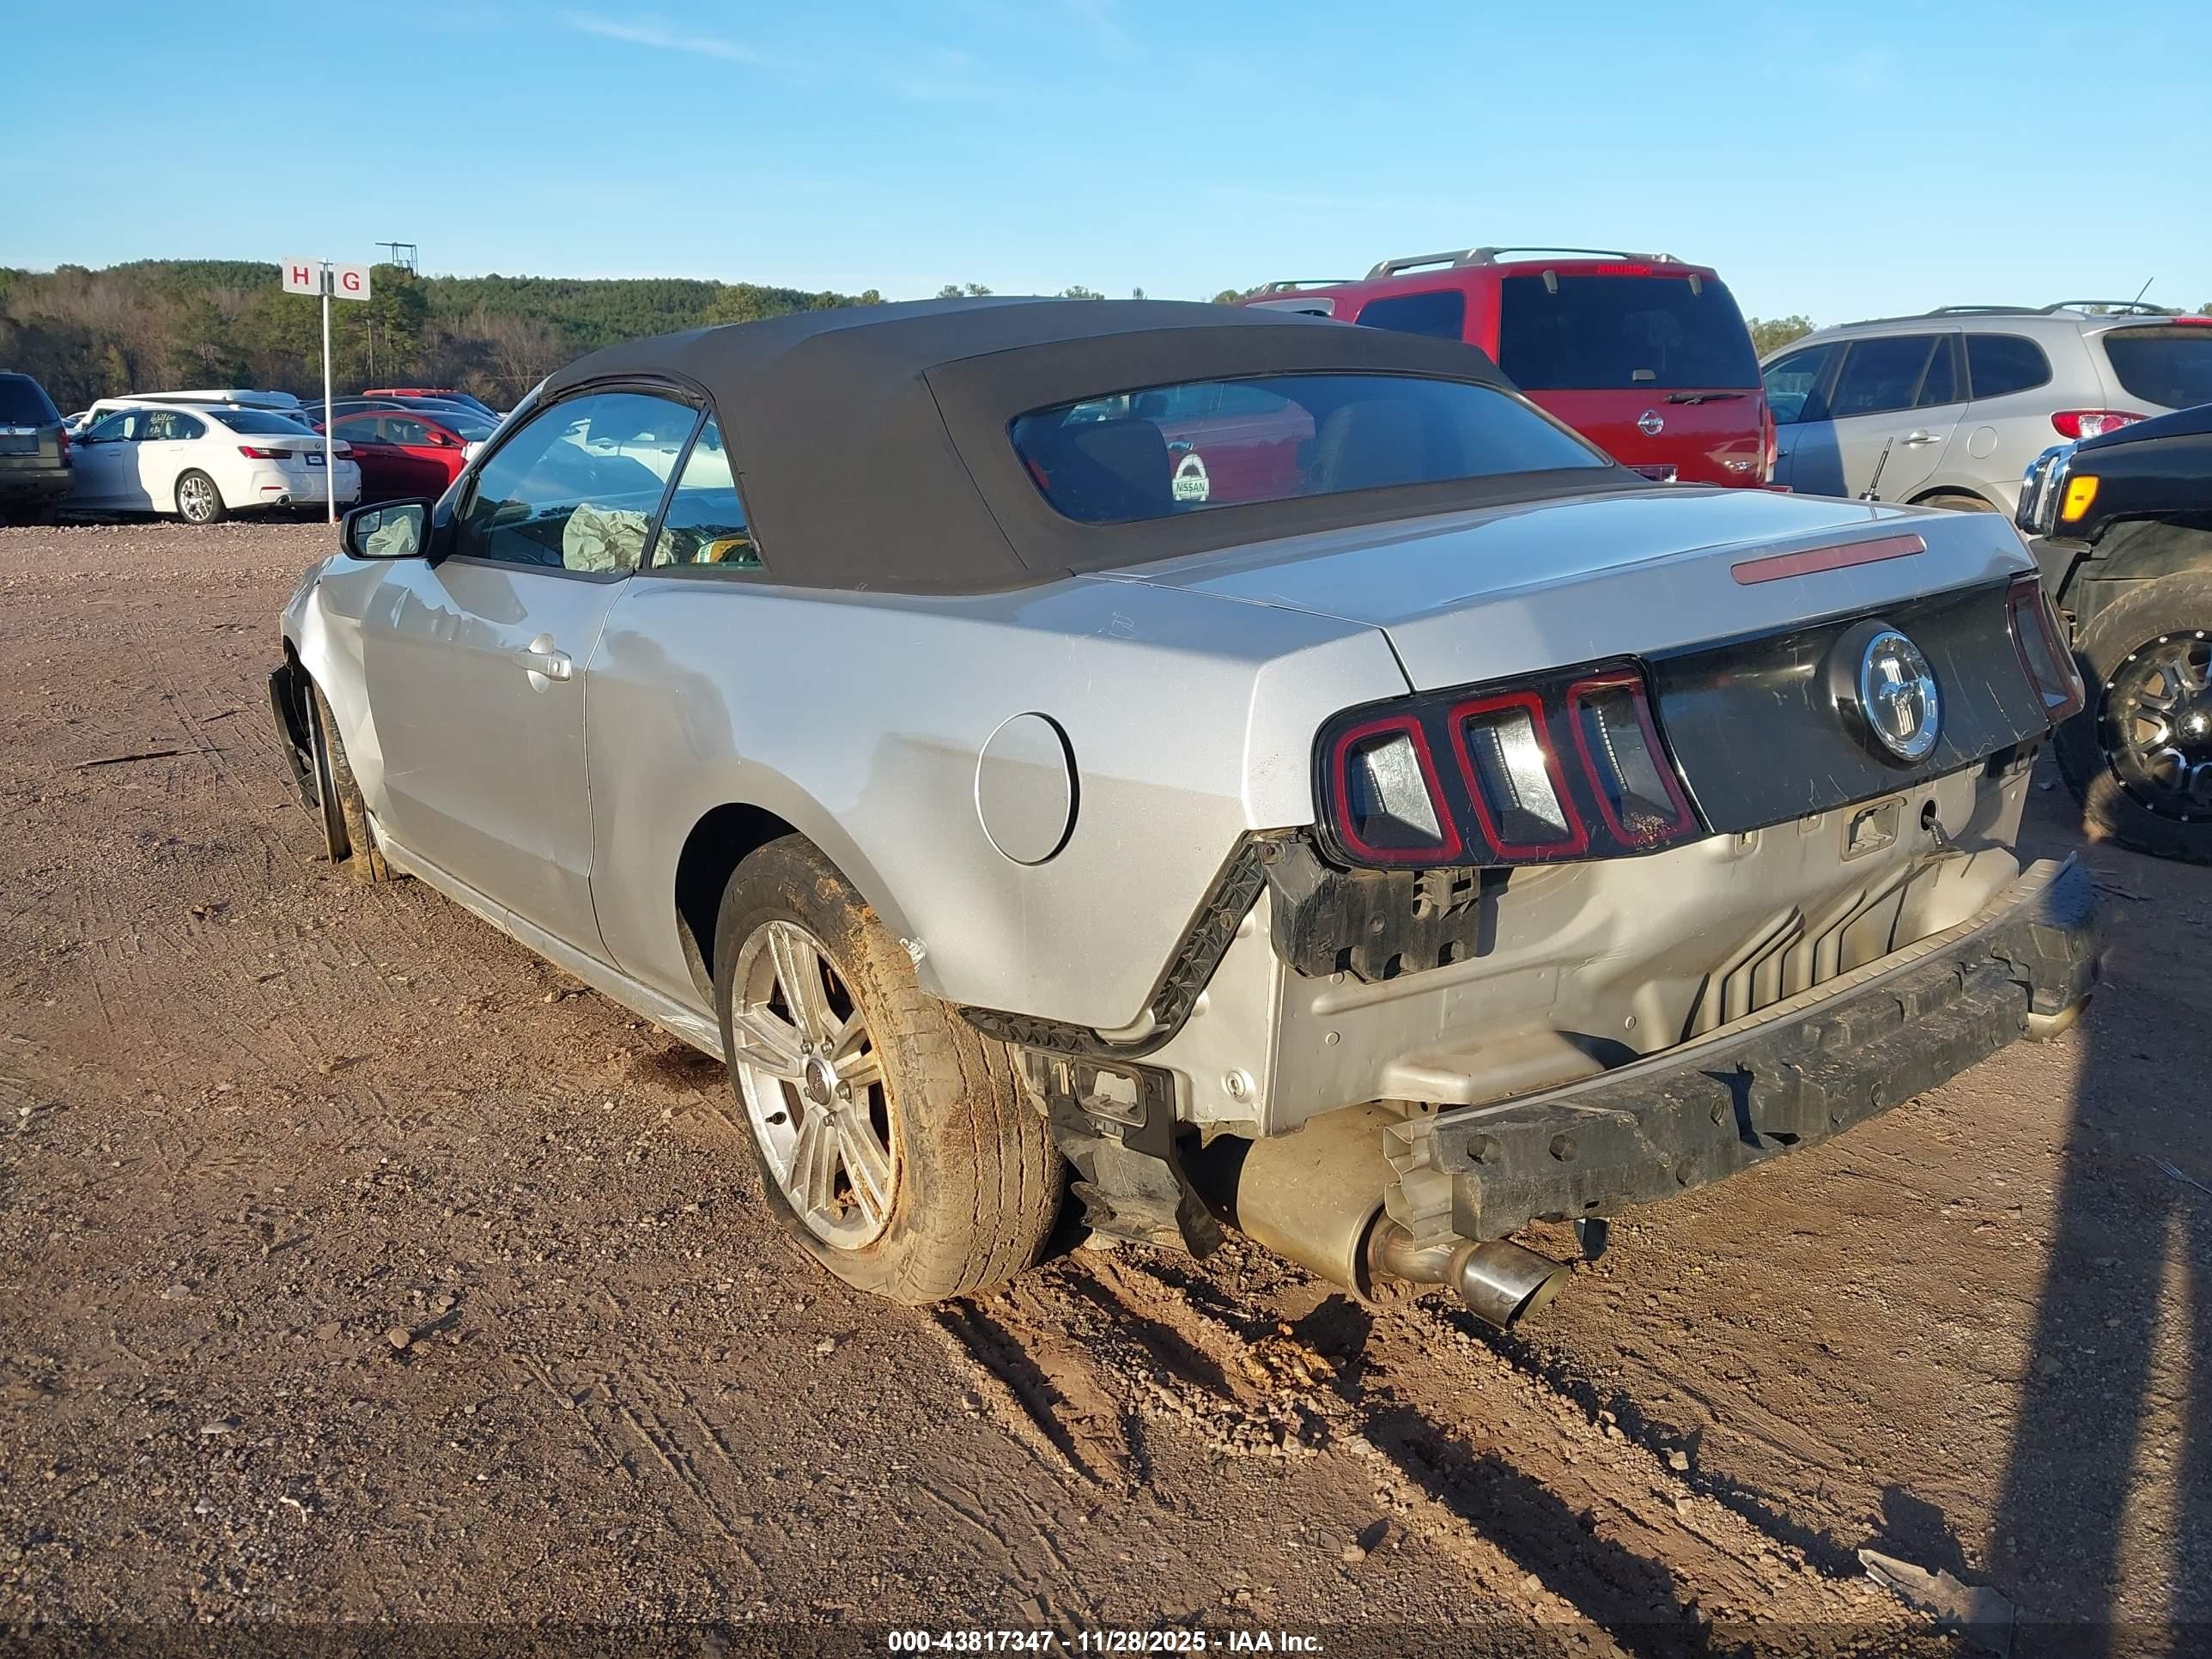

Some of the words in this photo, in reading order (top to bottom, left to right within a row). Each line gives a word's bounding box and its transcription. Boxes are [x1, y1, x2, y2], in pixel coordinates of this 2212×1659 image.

[293, 265, 309, 285] H
[343, 271, 360, 291] G
[1176, 482, 1206, 493] NISSAN
